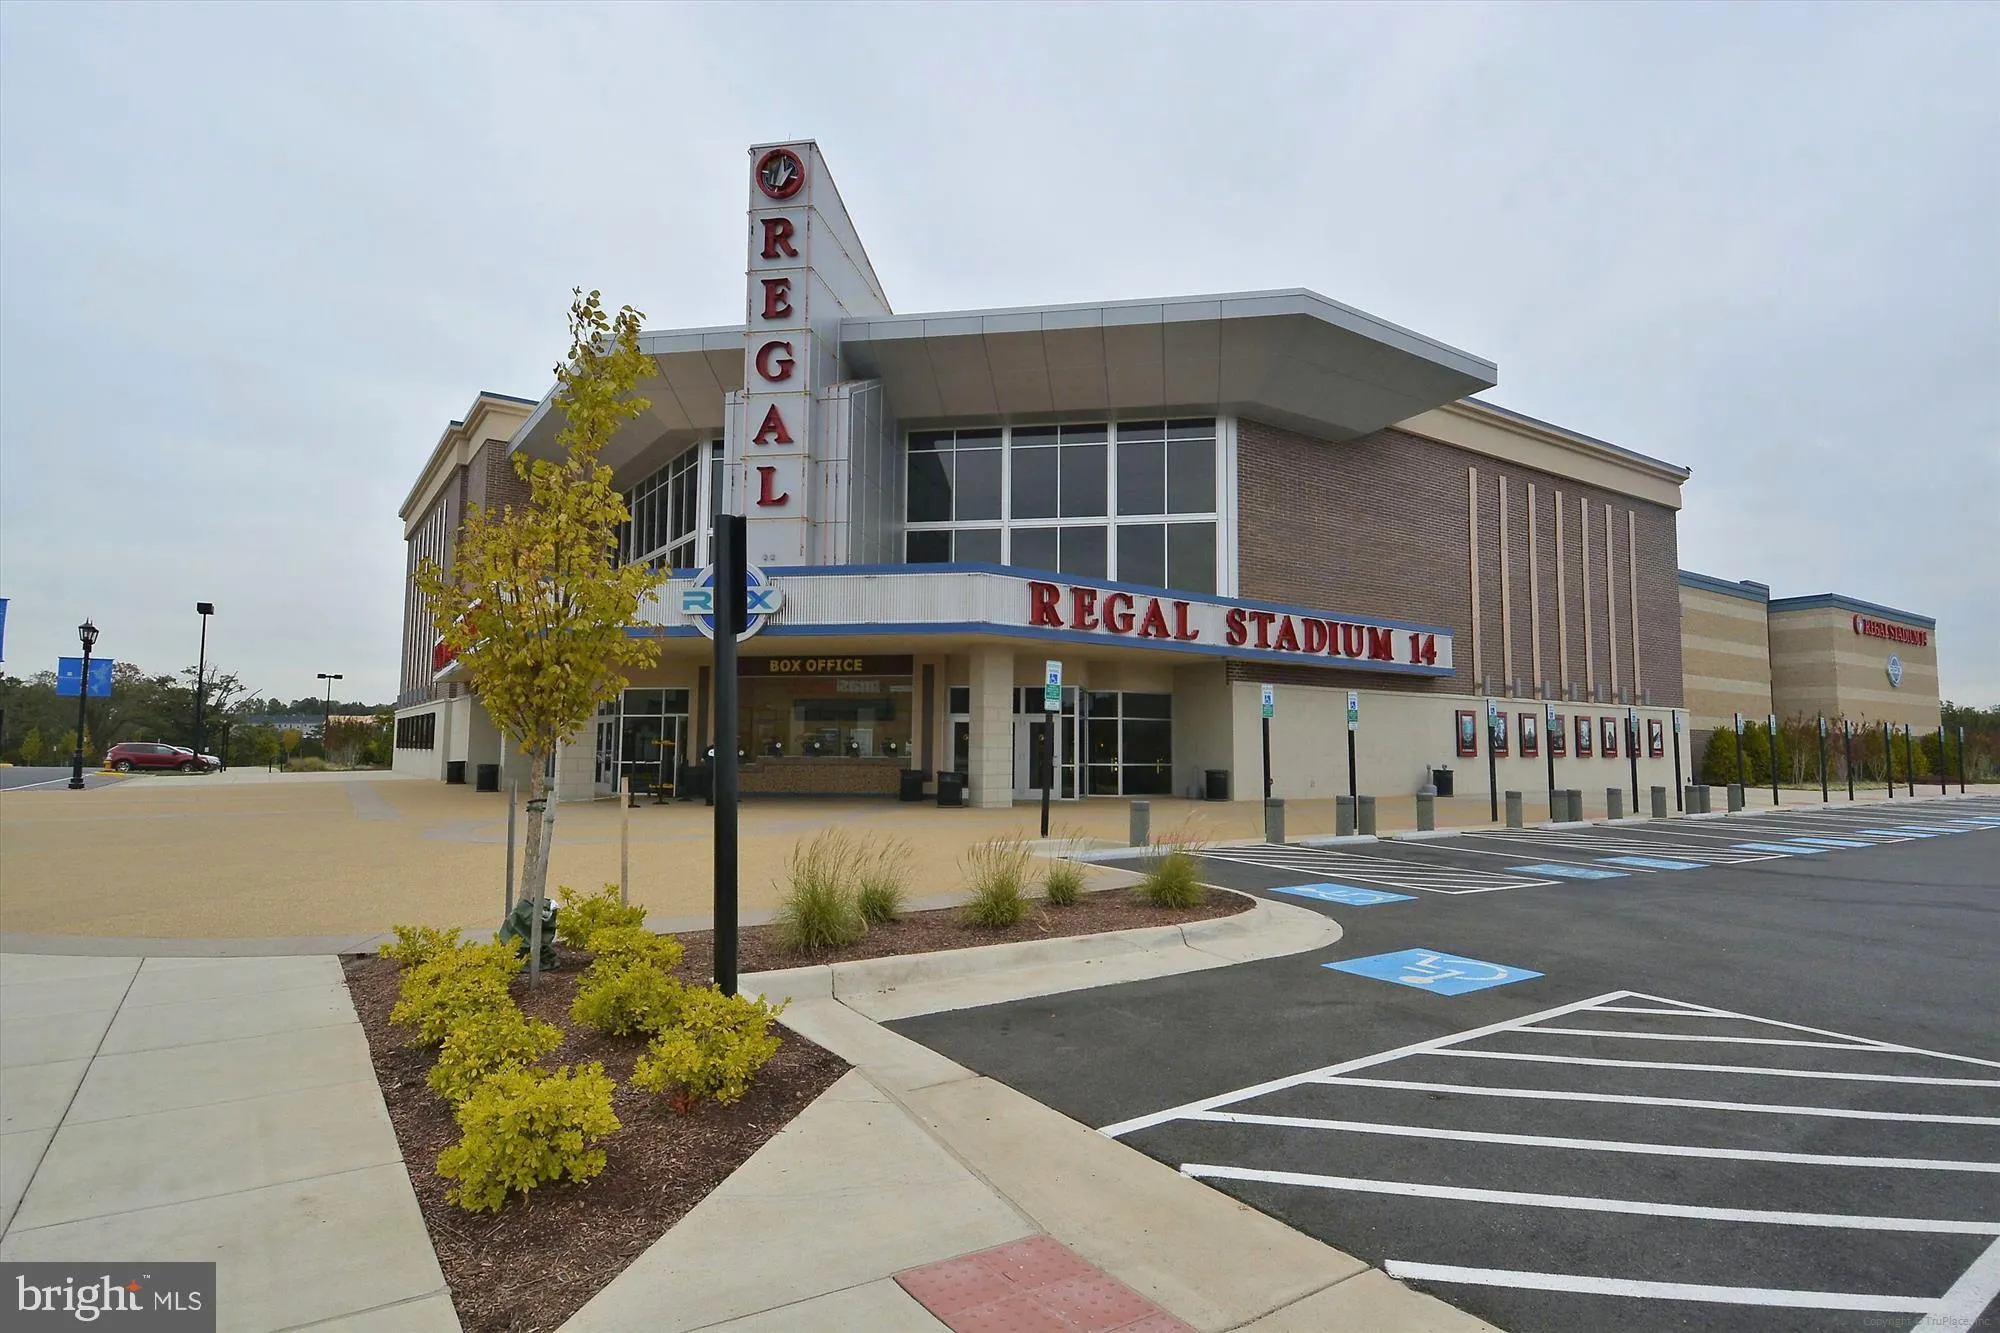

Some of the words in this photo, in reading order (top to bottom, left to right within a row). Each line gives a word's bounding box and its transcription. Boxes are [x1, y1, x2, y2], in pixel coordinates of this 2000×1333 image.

[752, 217, 798, 507] REGAL
[683, 590, 774, 610] RX
[1027, 581, 1200, 641] REGAL
[1226, 608, 1394, 661] STADIUM
[1409, 632, 1437, 666] 14
[769, 659, 801, 672] BOX
[806, 658, 863, 672] OFFICE
